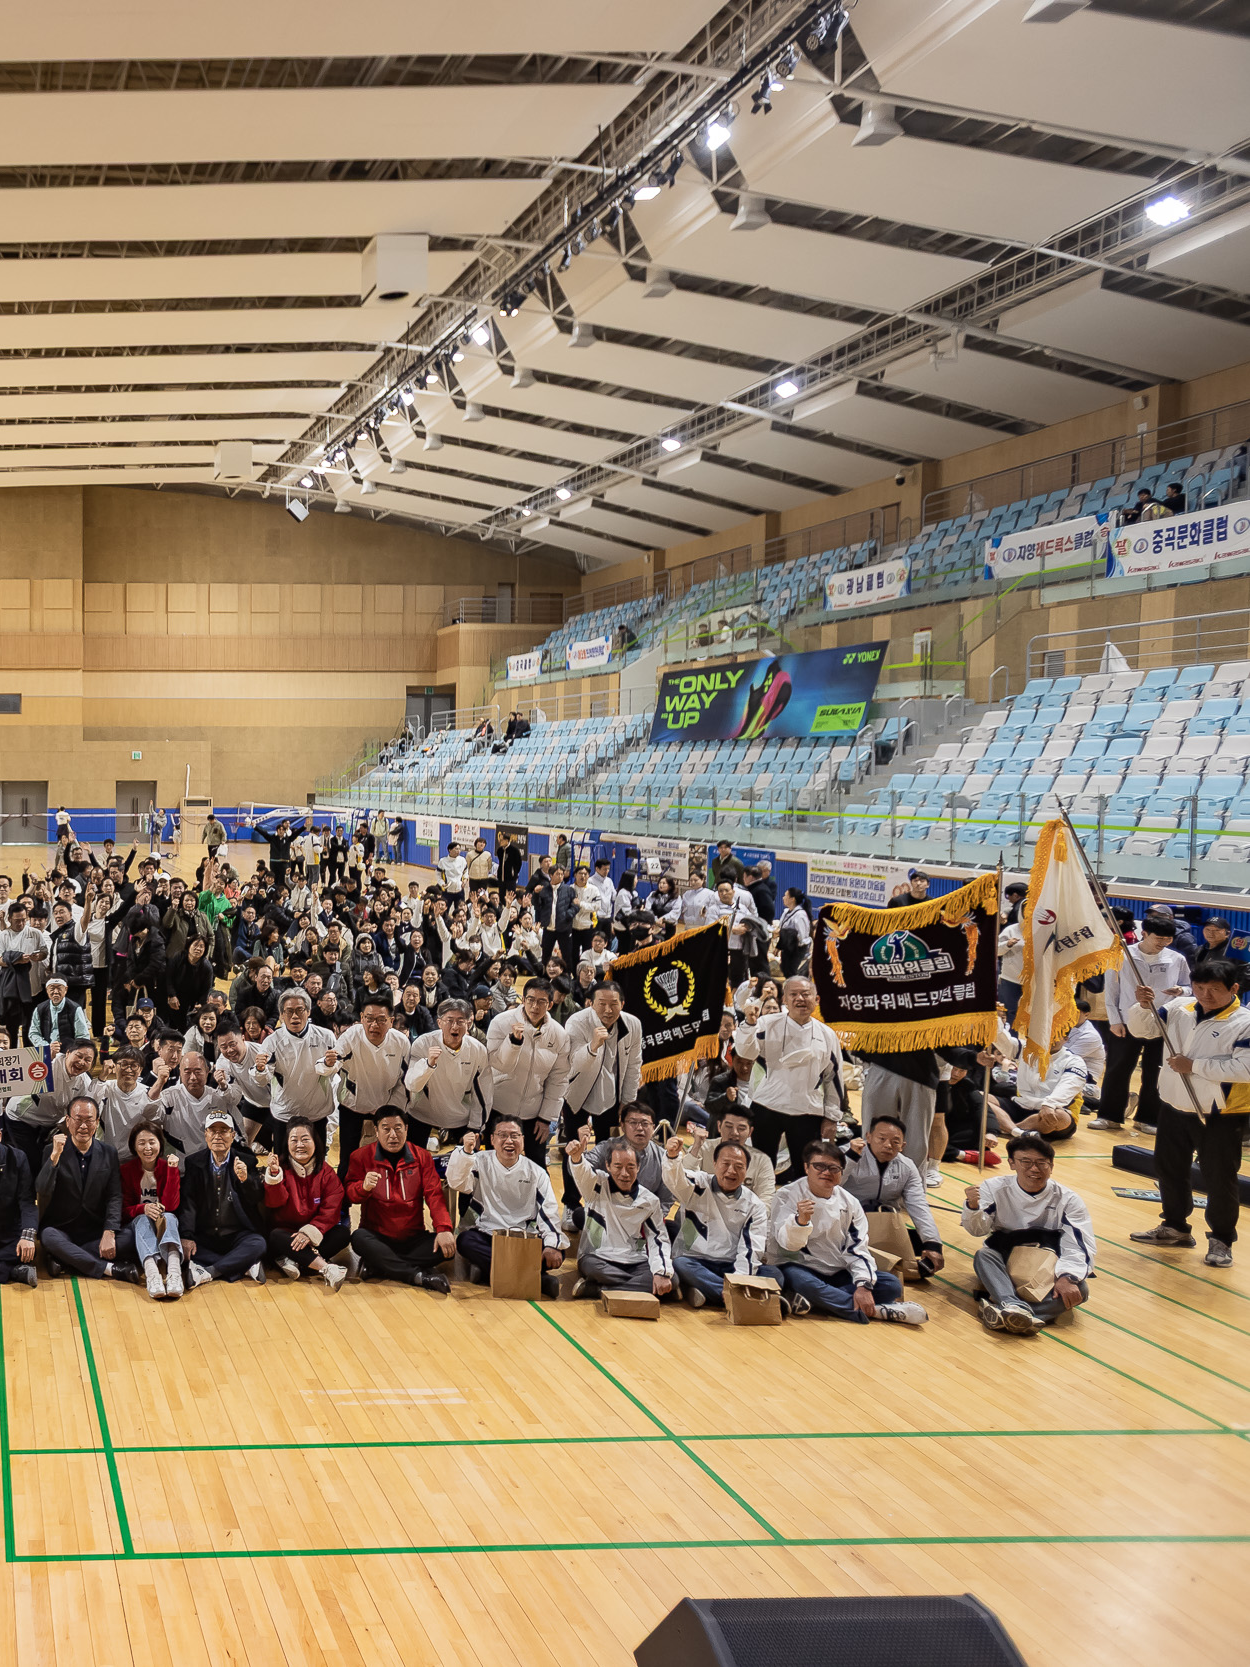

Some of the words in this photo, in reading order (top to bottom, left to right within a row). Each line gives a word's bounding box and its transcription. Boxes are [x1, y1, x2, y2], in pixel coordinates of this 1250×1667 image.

[1016, 529, 1095, 561] 자양레드콕스클럽
[1152, 515, 1229, 554] 중곡문화클럽
[846, 570, 884, 595] 광남클럽
[857, 649, 881, 663] YONEX
[668, 678, 680, 686] THE
[679, 669, 745, 693] ONLY
[665, 691, 718, 712] WAY
[667, 711, 700, 730] UP
[864, 954, 951, 976] 자양파워클럽
[838, 981, 976, 1011] 자양파워배드민턴클럽
[30, 1063, 46, 1078] 승
